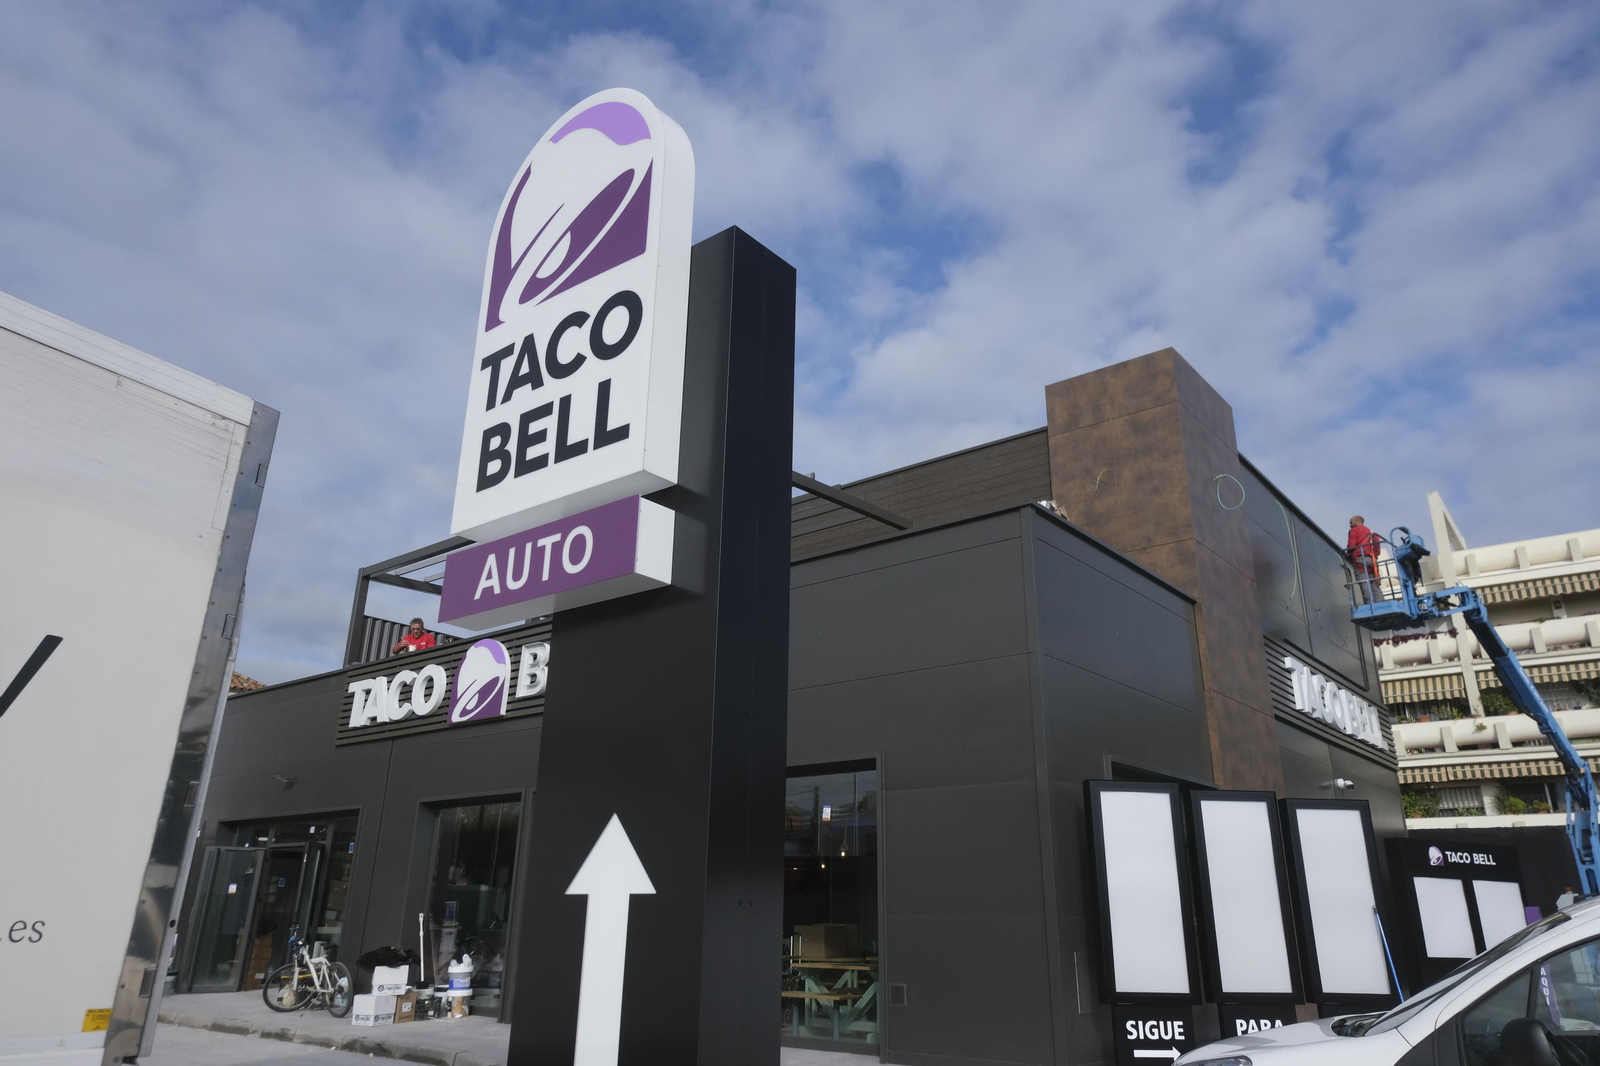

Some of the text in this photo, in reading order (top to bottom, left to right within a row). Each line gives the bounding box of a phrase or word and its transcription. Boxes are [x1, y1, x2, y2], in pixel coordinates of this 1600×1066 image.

[480, 289, 643, 412] TACO
[475, 378, 630, 493] BELL
[473, 525, 594, 600] AUTO
[348, 663, 447, 728] TACO
[1445, 851, 1497, 866] TACO BELL
[1126, 1020, 1185, 1040] SIGUE
